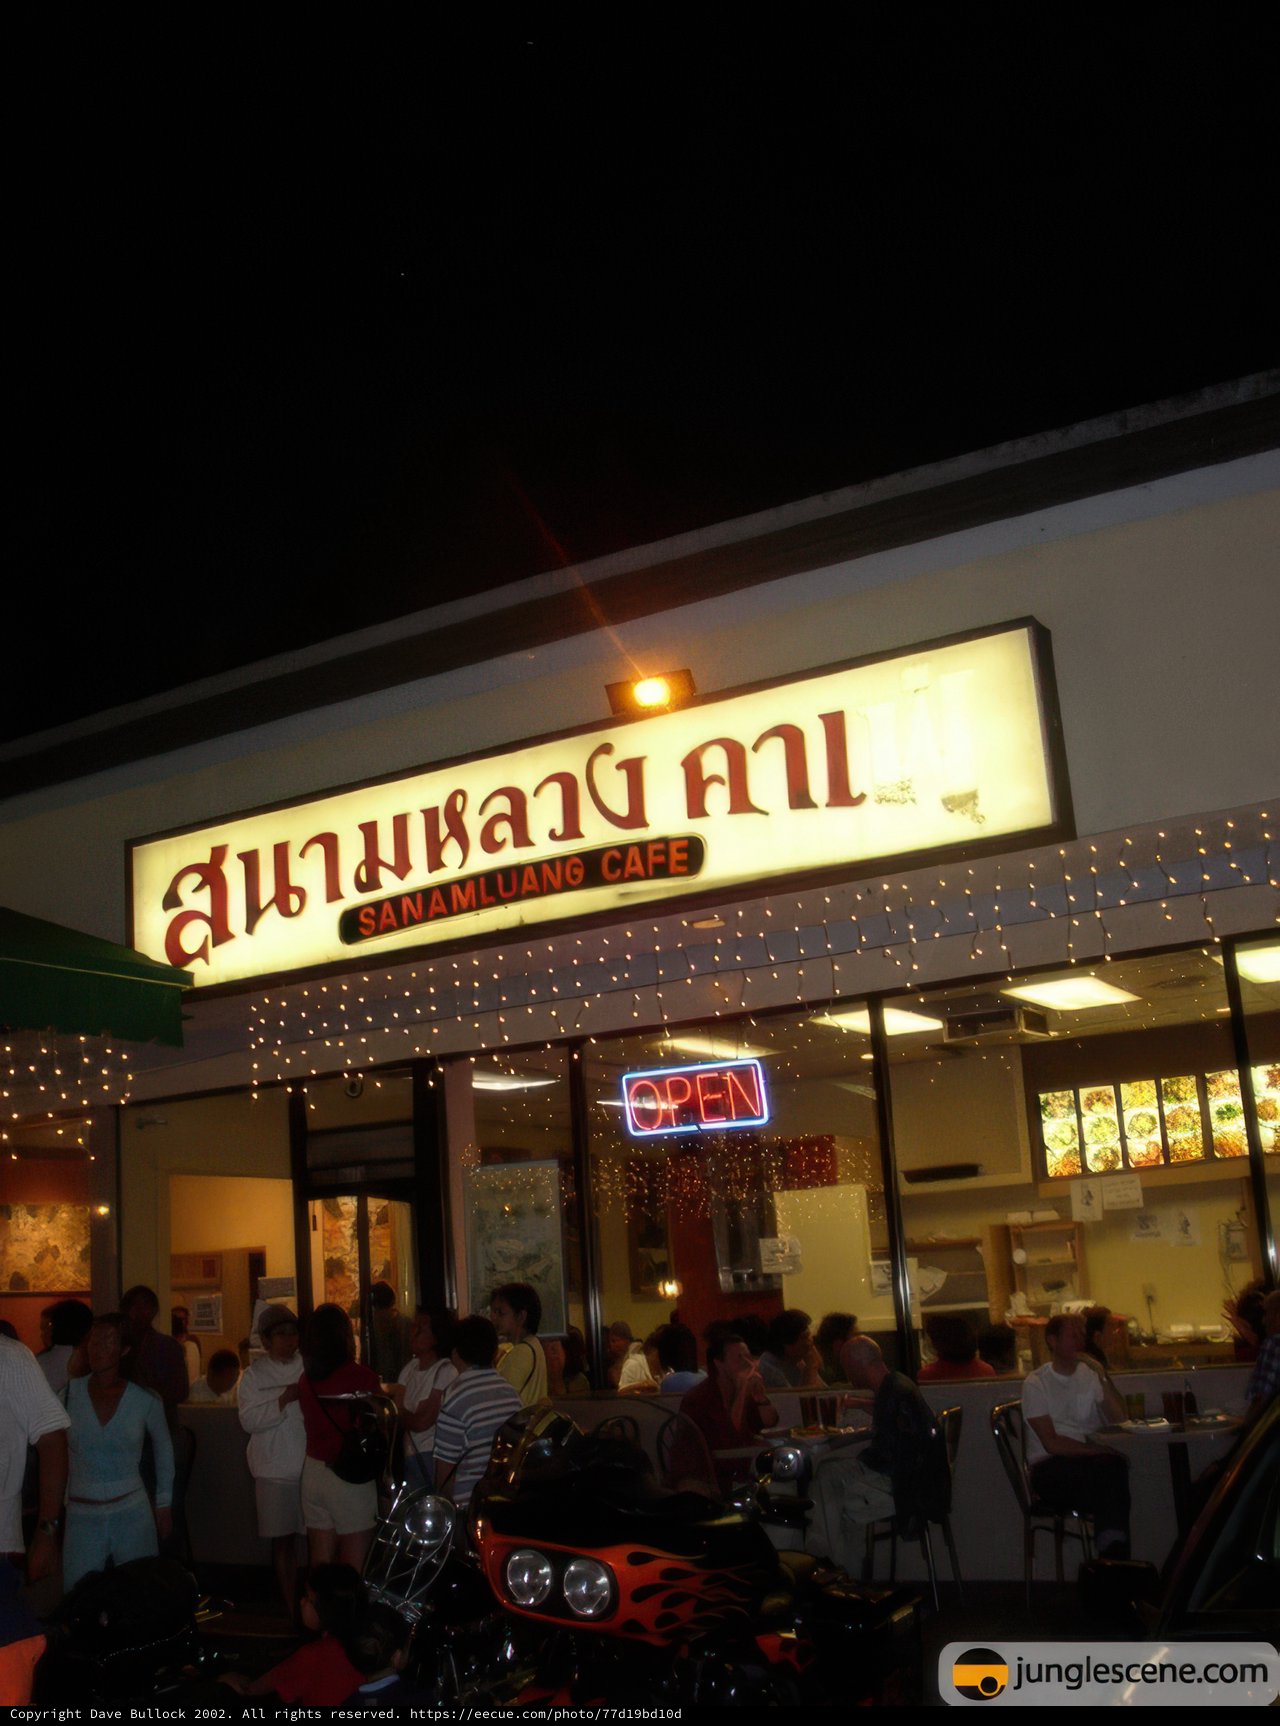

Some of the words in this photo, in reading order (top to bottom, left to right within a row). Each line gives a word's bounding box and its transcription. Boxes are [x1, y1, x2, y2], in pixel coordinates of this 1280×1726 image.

[161, 742, 650, 968] สนามหลวง
[357, 856, 585, 937] SANAMLUANG
[601, 838, 690, 882] CAFE
[628, 1065, 762, 1131] OPEN
